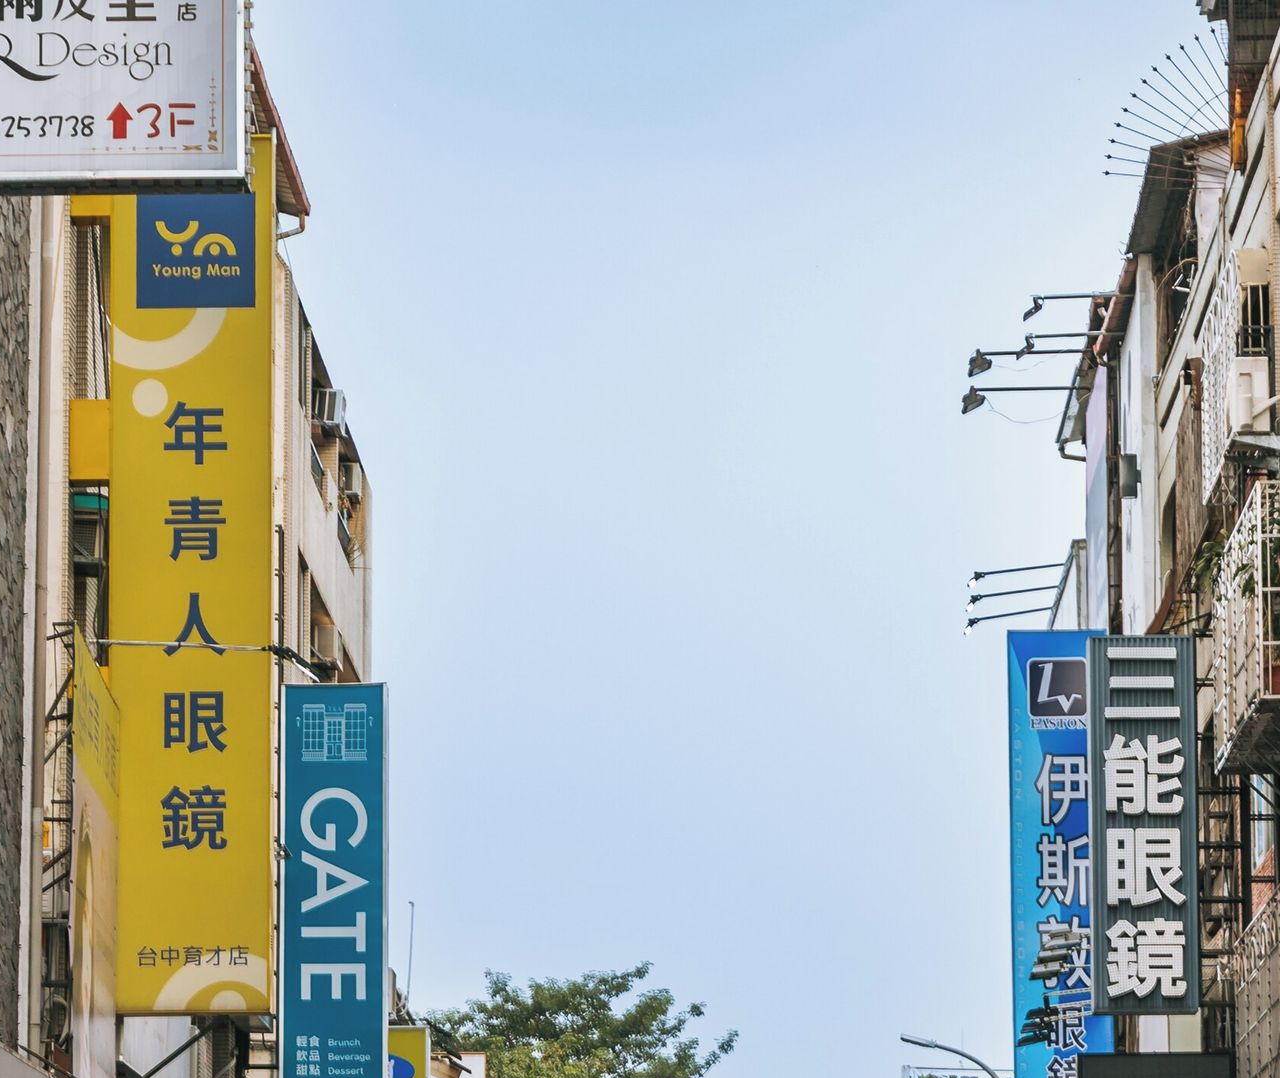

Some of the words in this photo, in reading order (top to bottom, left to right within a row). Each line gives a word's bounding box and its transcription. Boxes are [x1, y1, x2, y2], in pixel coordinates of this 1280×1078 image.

[38, 32, 173, 80] Design
[136, 102, 197, 140] 3F
[152, 263, 202, 280] Young
[207, 263, 241, 278] Man
[161, 401, 228, 851] 年青人眼鏡
[1102, 645, 1188, 1000] 三能眼鏡
[300, 787, 370, 1001] GATE
[137, 945, 250, 968] 台中育才店
[296, 1035, 320, 1047] 輕食
[327, 1038, 361, 1047] Brunch
[296, 1050, 321, 1062] 飲品
[327, 1052, 371, 1062] Beverage
[327, 1066, 364, 1076] Dessert
